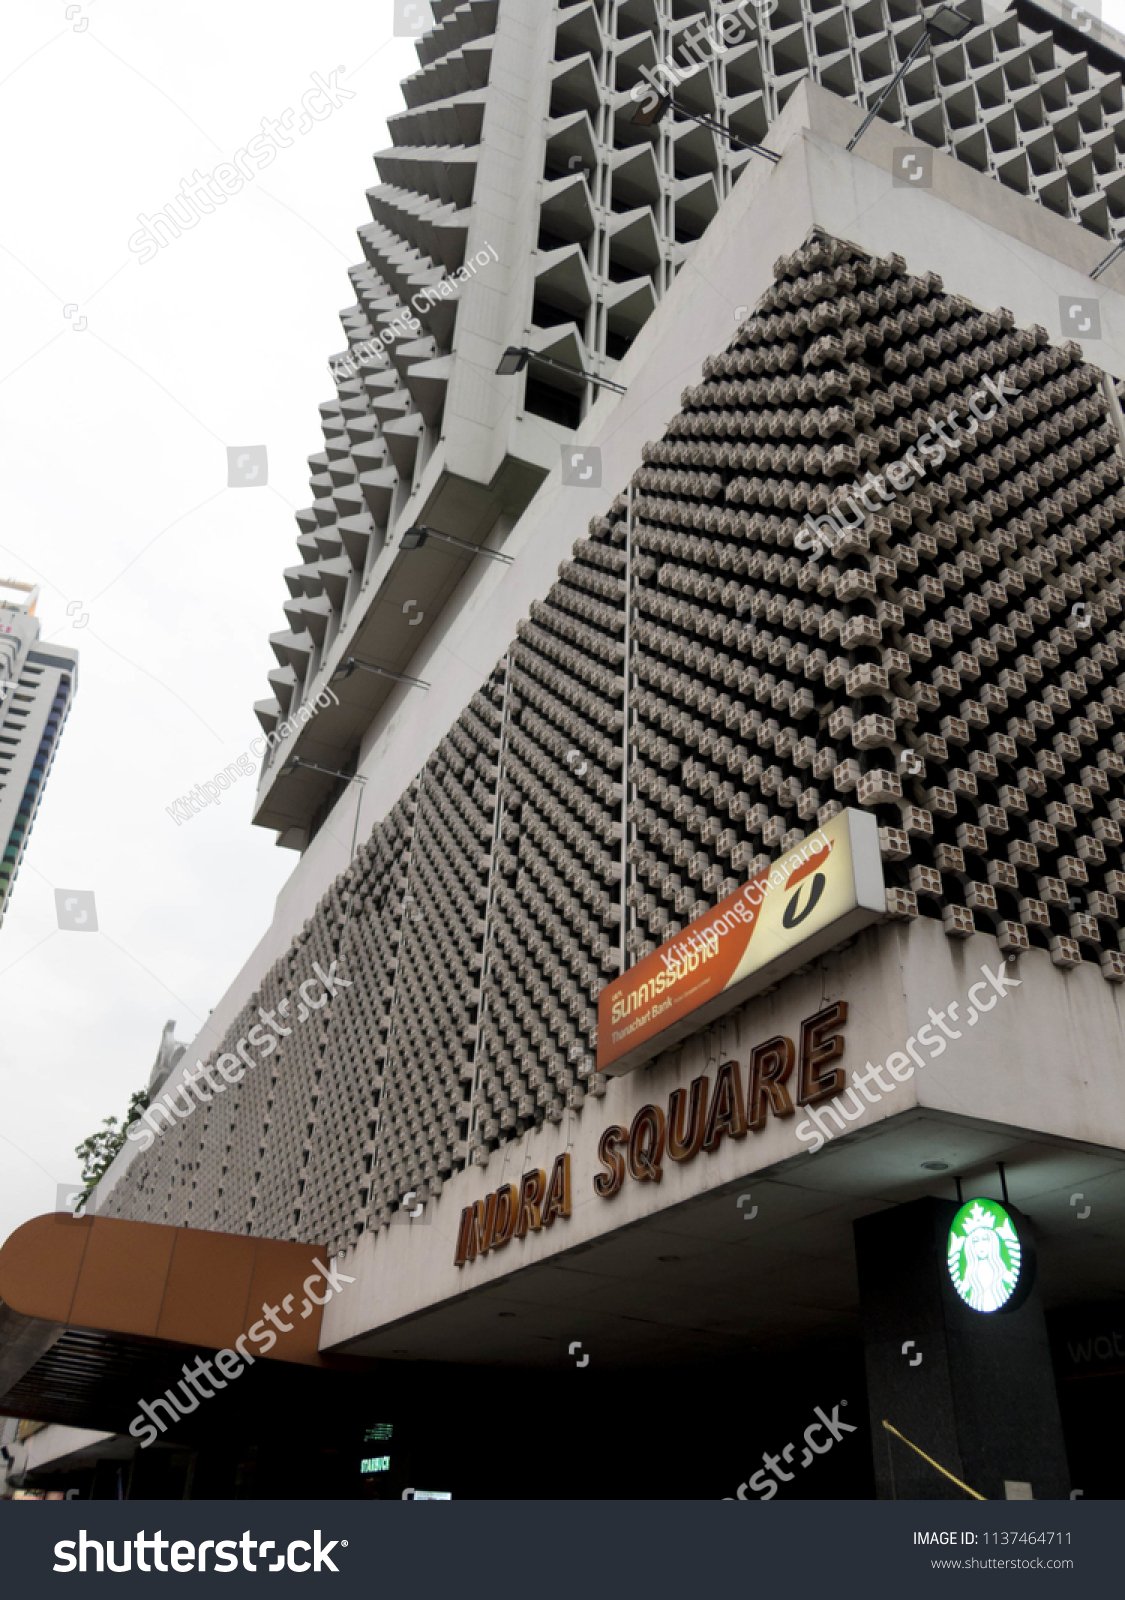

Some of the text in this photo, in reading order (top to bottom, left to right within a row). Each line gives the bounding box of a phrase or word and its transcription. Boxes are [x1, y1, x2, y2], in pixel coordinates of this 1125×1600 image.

[651, 996, 673, 1019] Bank
[453, 1000, 849, 1267] INDRA SQUARE
